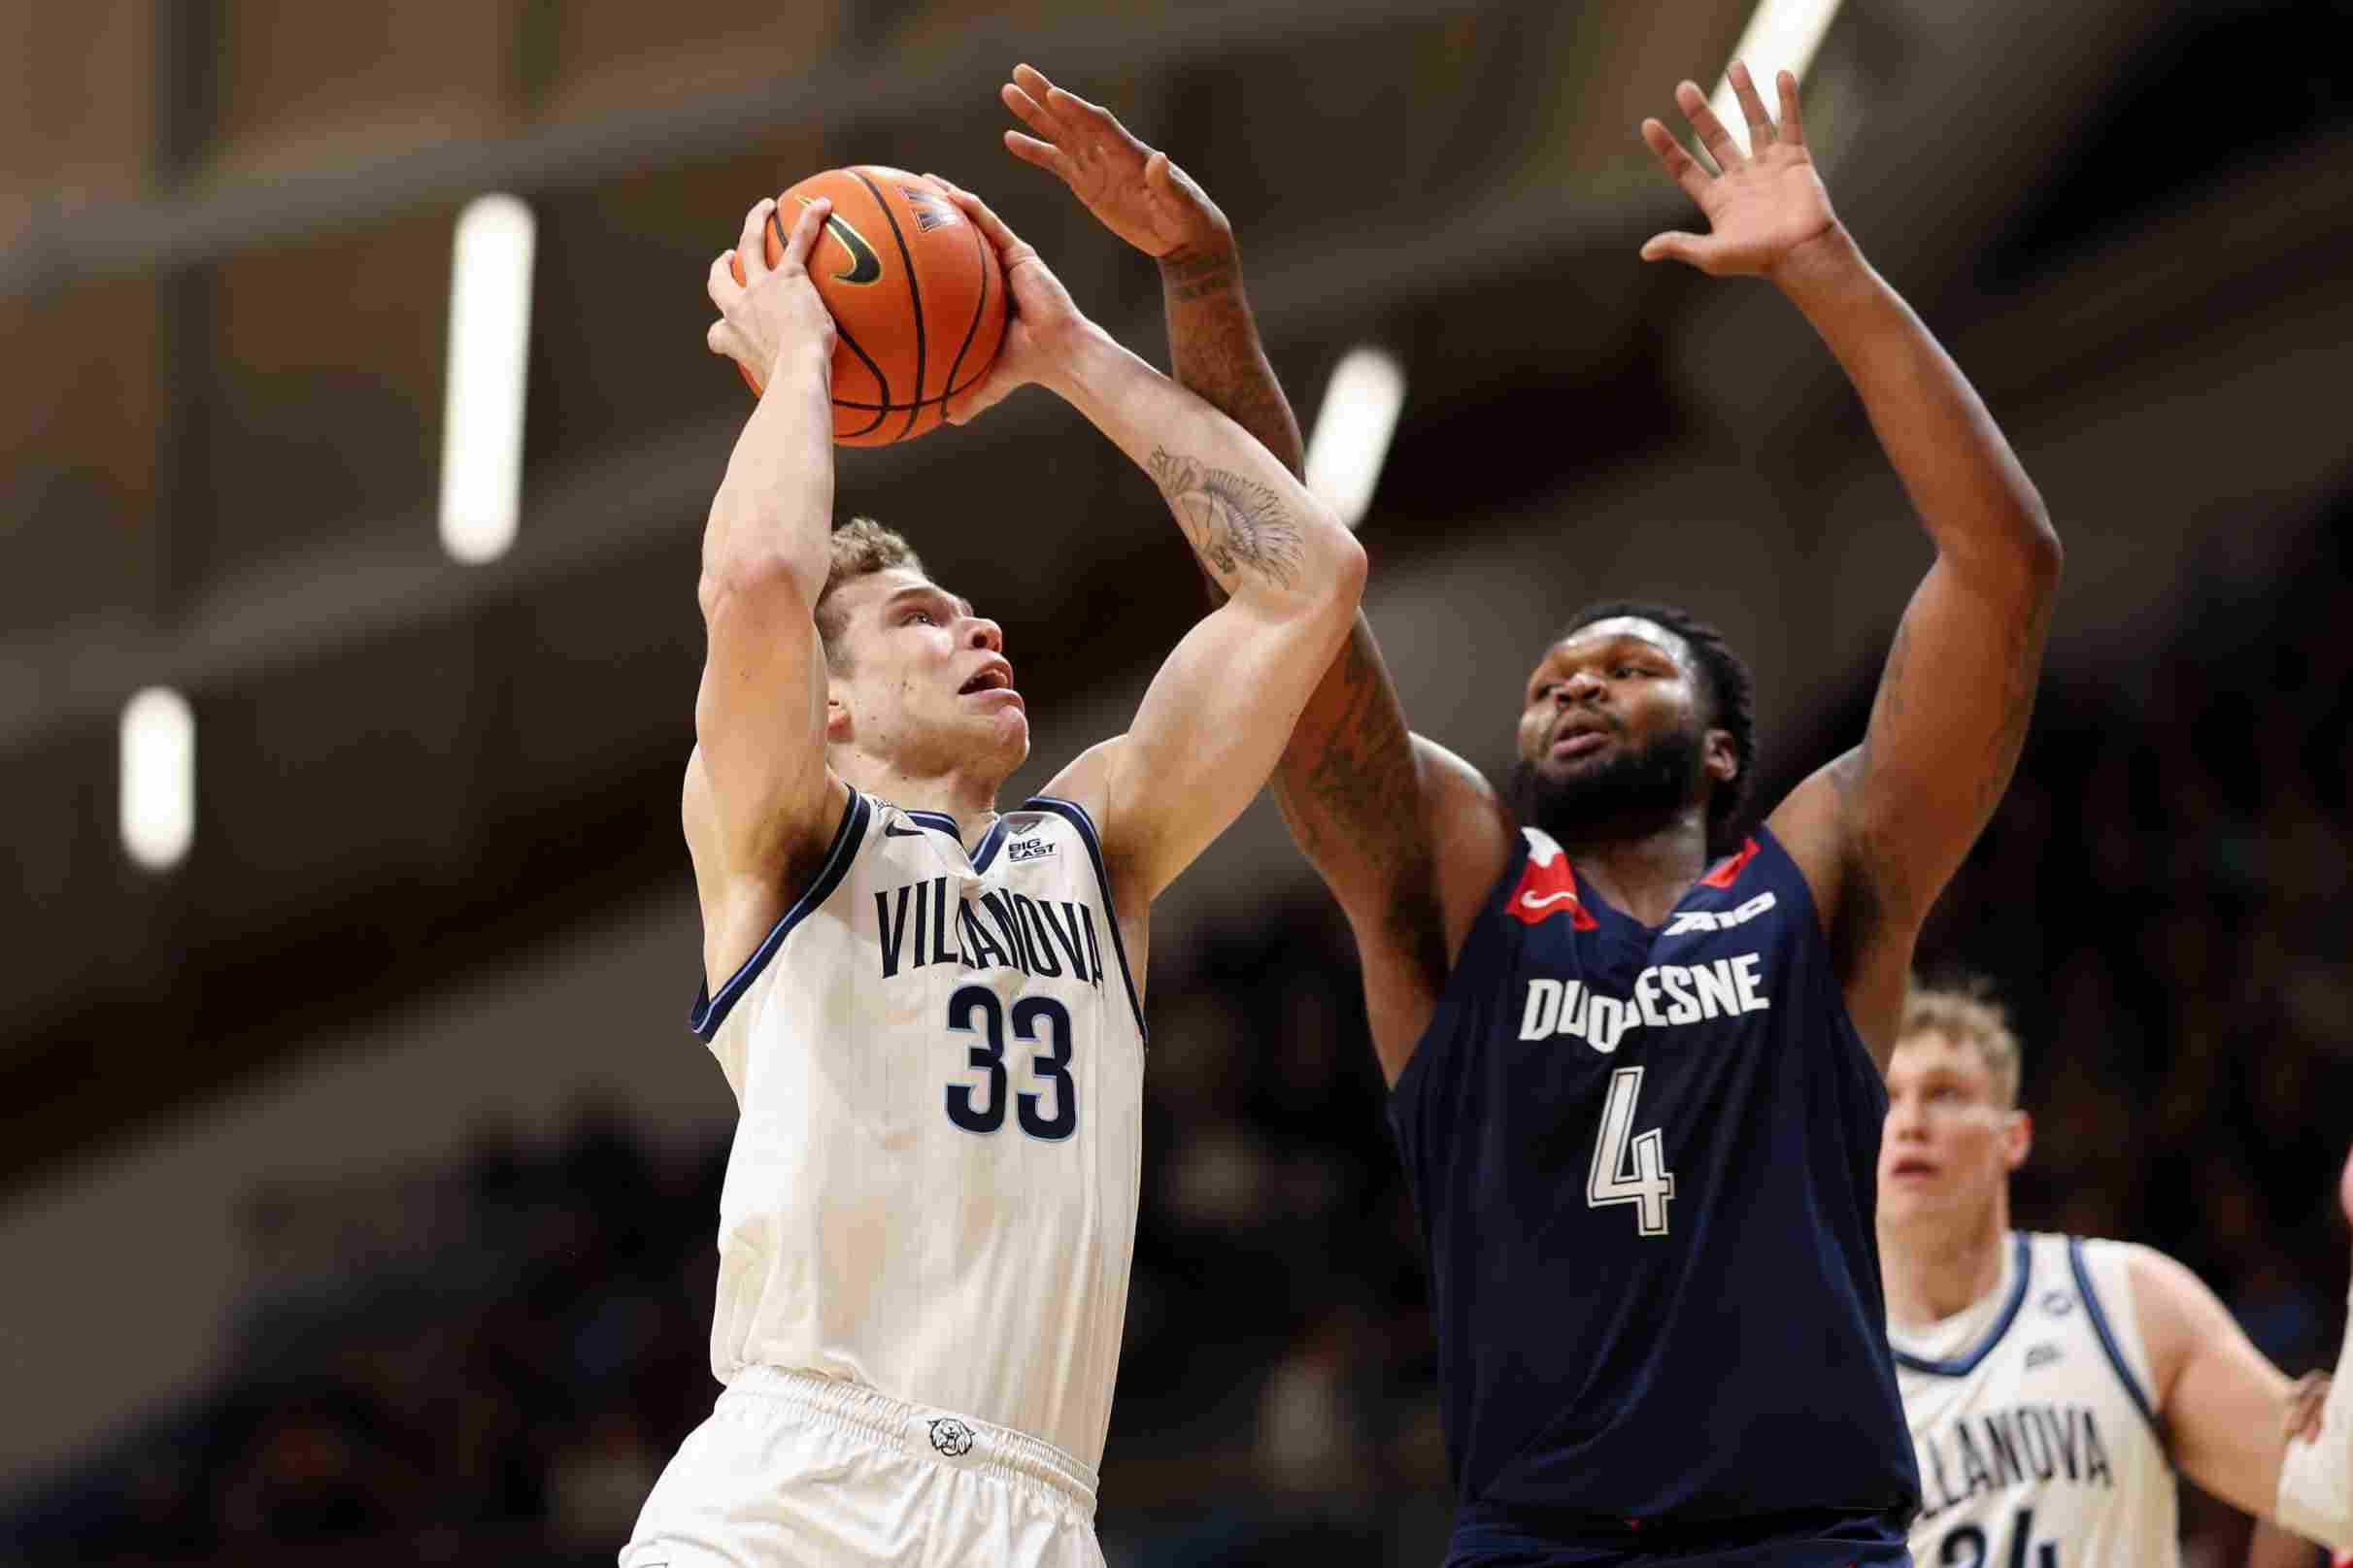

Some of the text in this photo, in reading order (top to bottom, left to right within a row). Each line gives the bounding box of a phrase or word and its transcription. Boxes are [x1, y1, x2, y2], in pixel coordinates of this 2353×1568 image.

[1009, 838, 1042, 852] BIG
[1009, 843, 1057, 860] EAST
[874, 877, 1104, 987] VILANOVA
[946, 984, 1077, 1144] 33
[1587, 1066, 1676, 1236] 4
